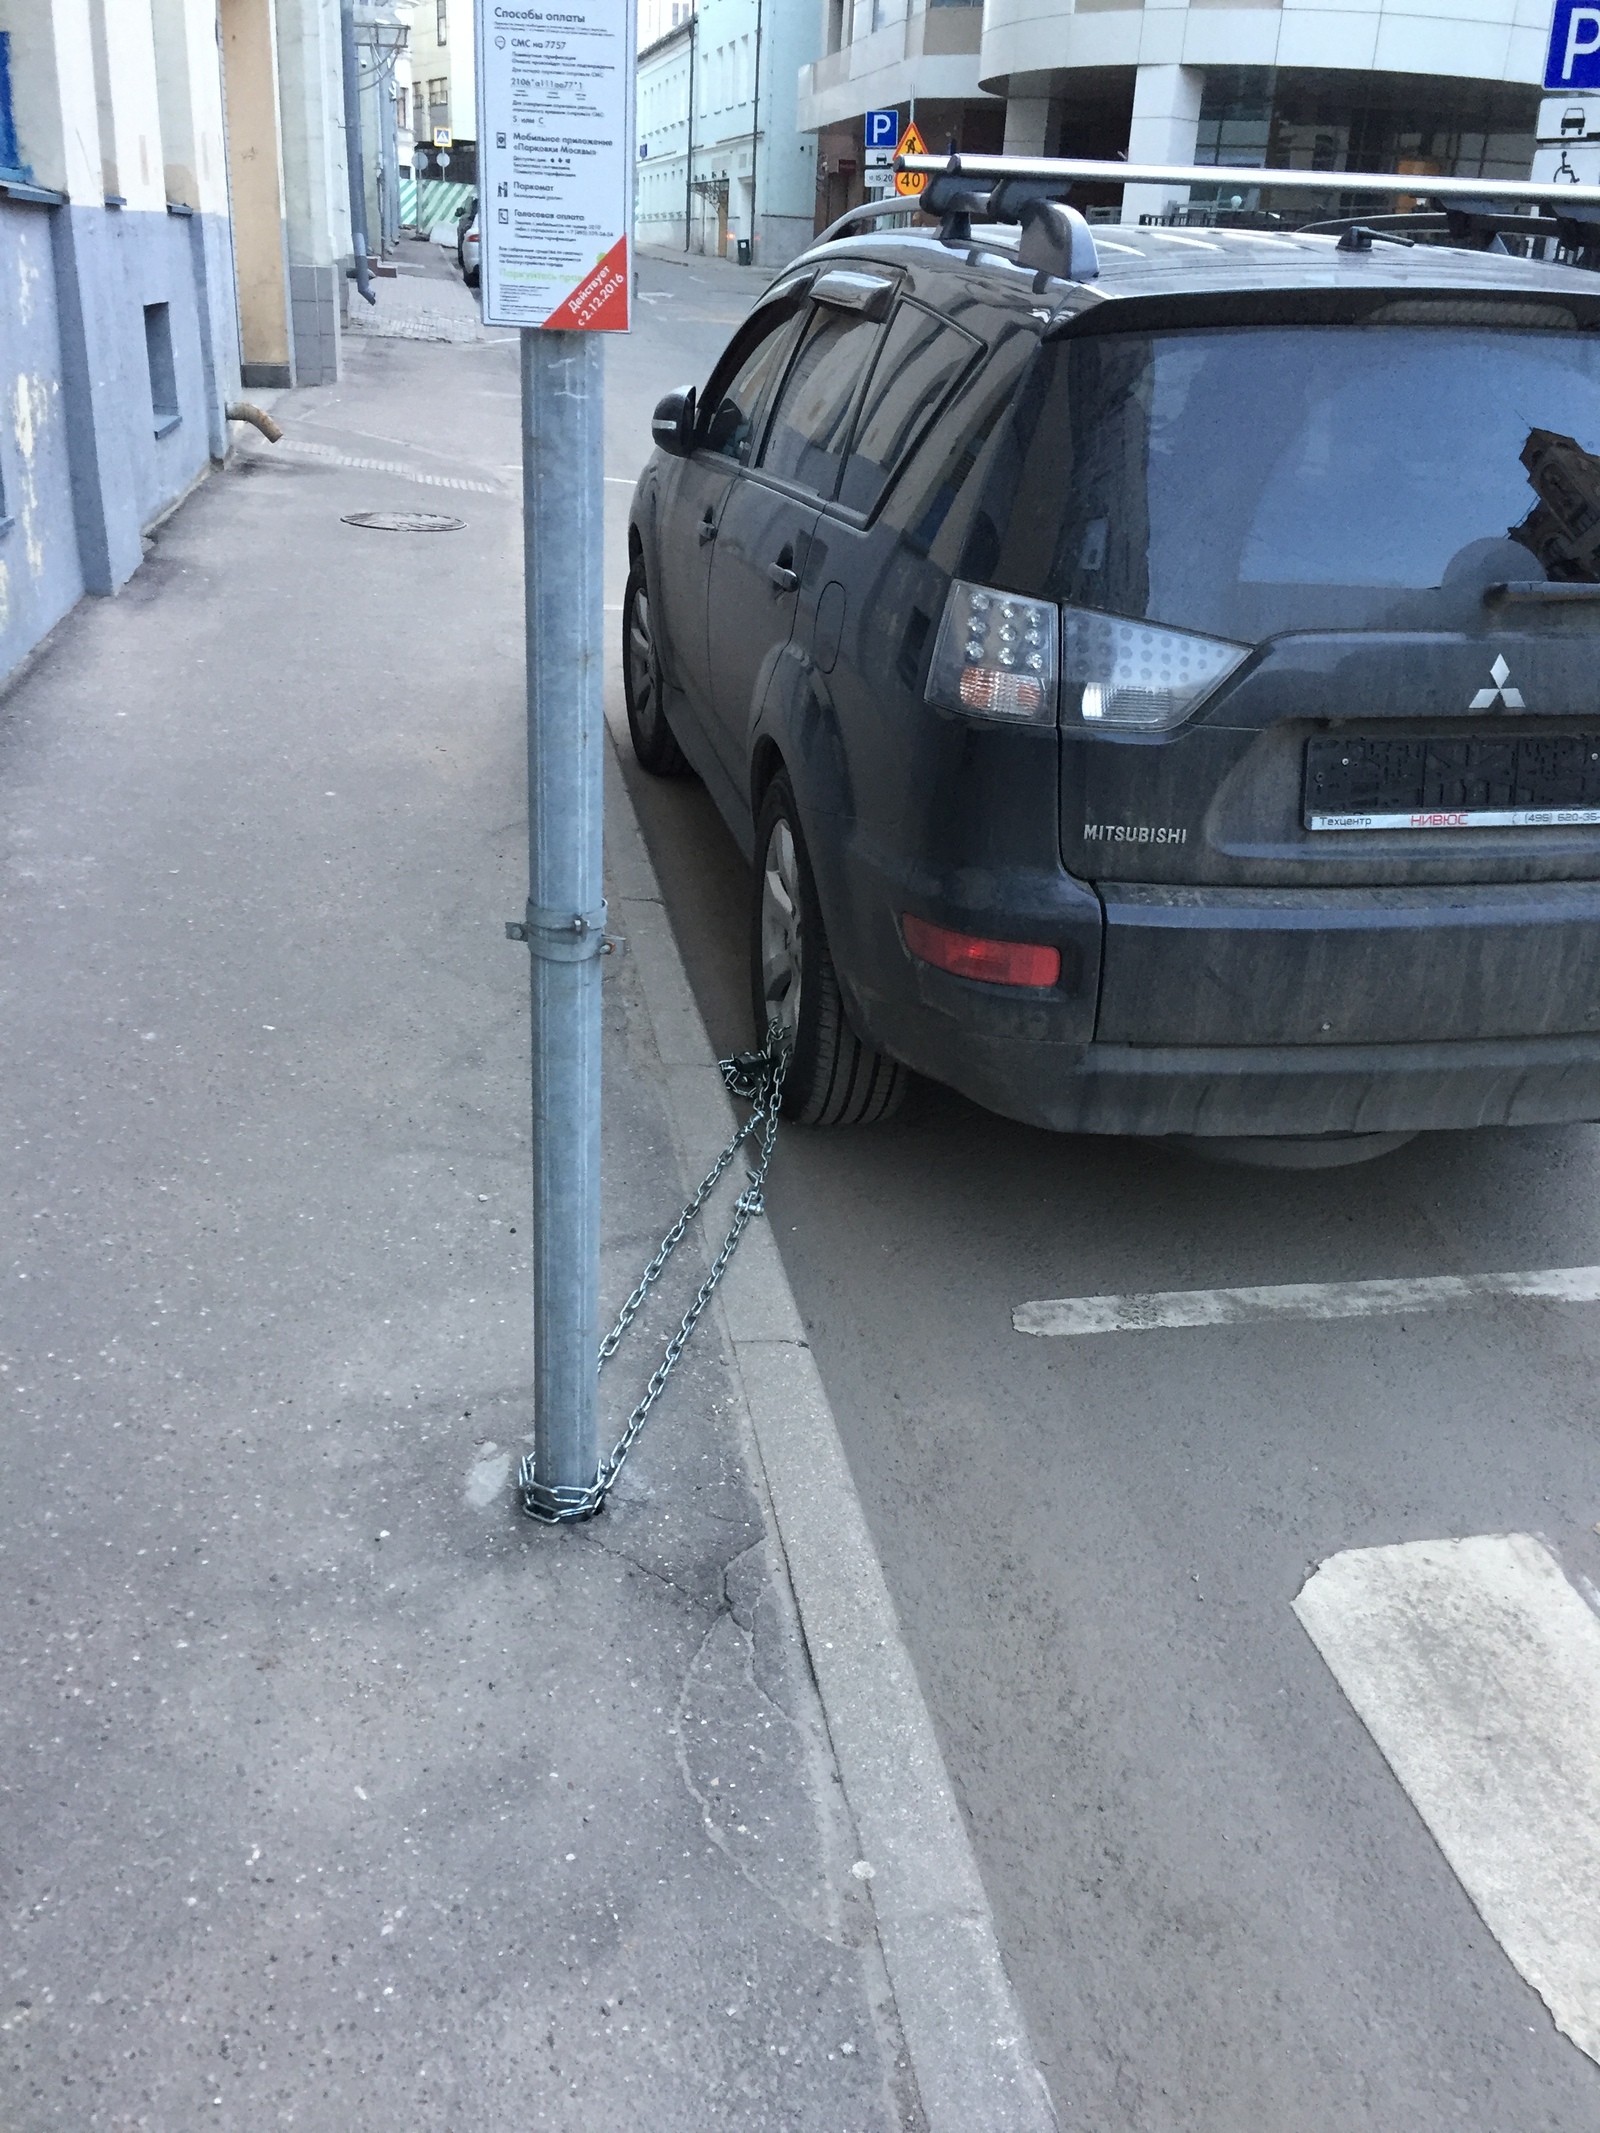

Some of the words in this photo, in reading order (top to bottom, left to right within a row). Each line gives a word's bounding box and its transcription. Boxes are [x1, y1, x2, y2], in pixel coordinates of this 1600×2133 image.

[494, 6, 543, 20] Способы
[545, 12, 586, 23] оплаты
[511, 38, 531, 48] СМС
[544, 40, 566, 50] 7757
[1561, 7, 1600, 80] P
[873, 114, 891, 144] P
[513, 132, 560, 143] Мобильное
[561, 137, 613, 147] приложение
[513, 143, 559, 153] «Парковки
[560, 146, 597, 155] Москвы»
[513, 181, 554, 192] Паркомат
[900, 172, 921, 188] 40
[514, 208, 555, 219] Голосовая
[567, 265, 610, 315] Действует
[580, 273, 625, 321] 2.12.2016
[577, 318, 586, 326] с
[1319, 816, 1372, 827] Техцентр
[1410, 813, 1469, 827] НИВЮС
[1083, 824, 1187, 844] MITSUBISHI
